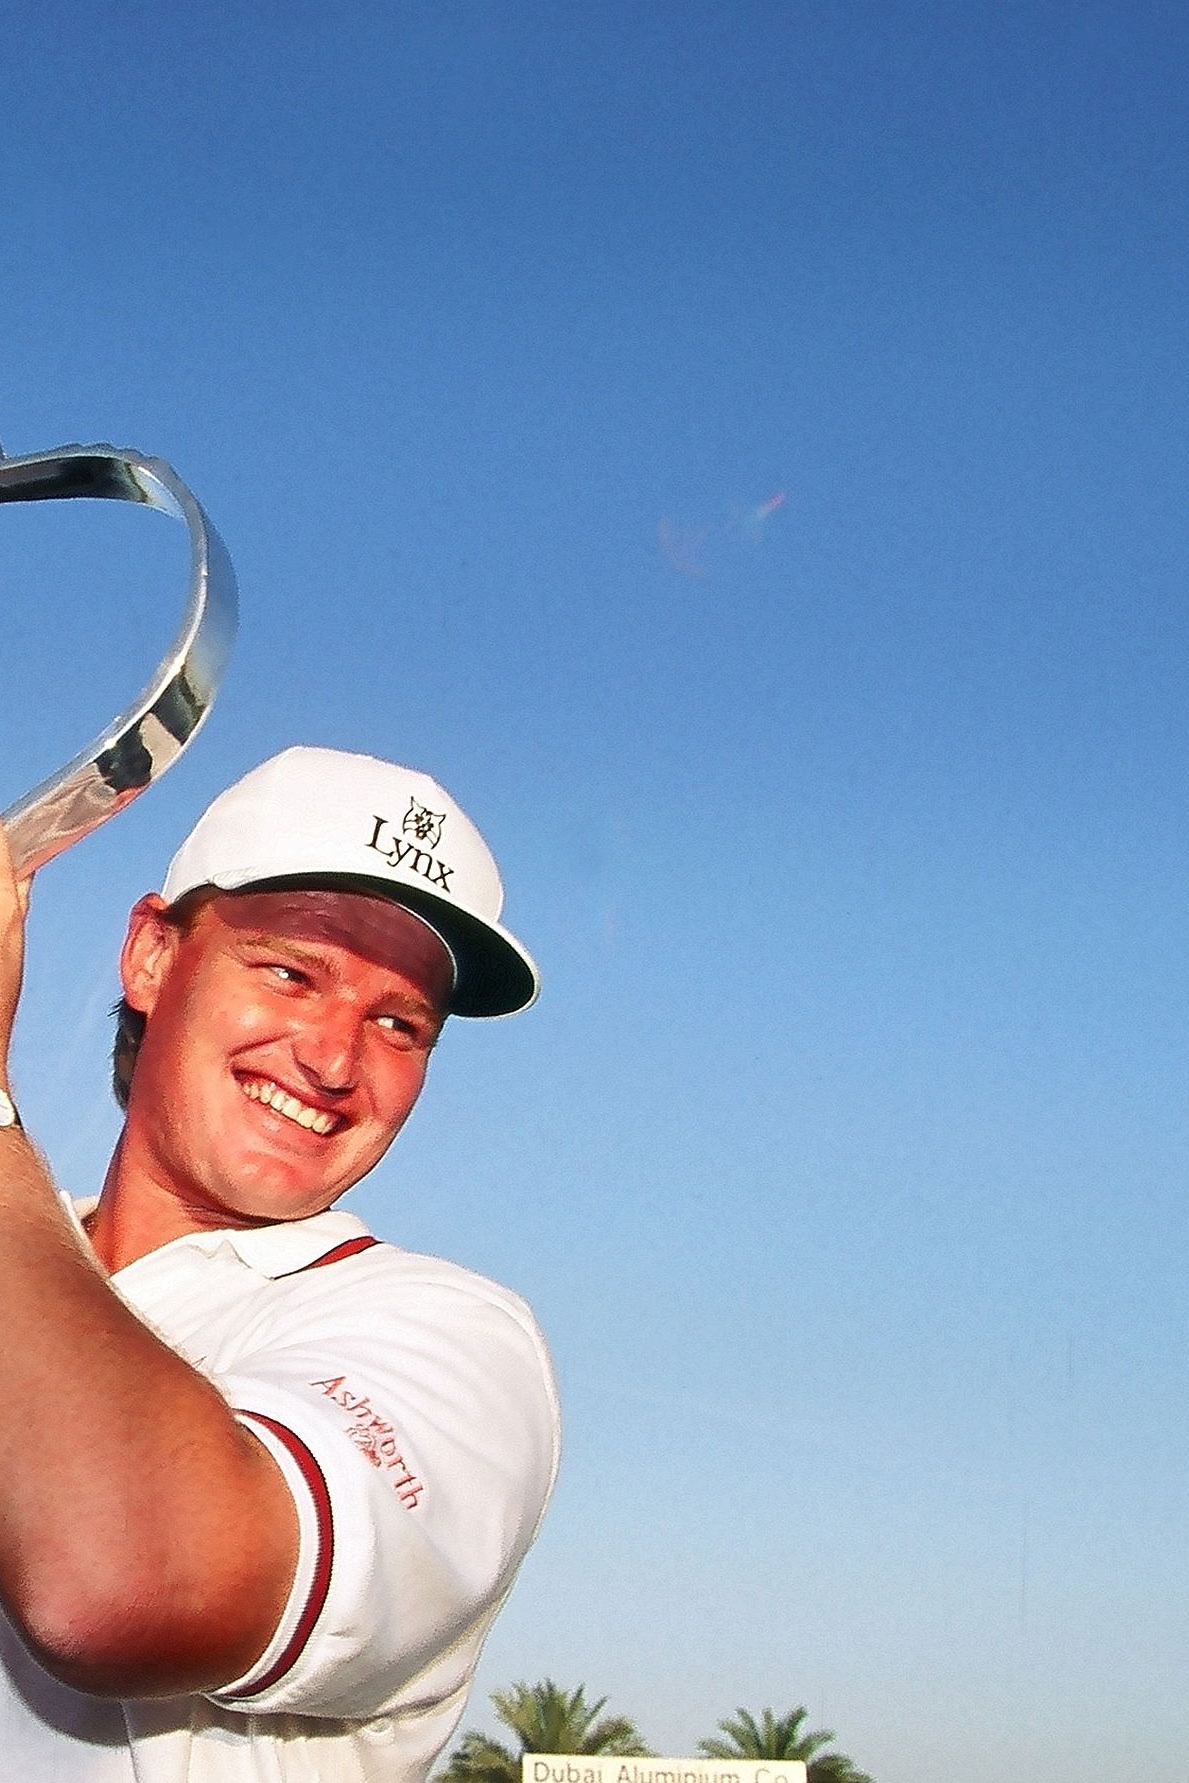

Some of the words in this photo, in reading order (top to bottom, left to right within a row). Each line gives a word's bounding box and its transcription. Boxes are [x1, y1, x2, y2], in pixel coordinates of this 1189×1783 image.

[364, 814, 454, 893] Lynx
[308, 1375, 424, 1510] Ashworth
[534, 1761, 602, 1783] Dubai
[618, 1765, 740, 1783] Aluminium
